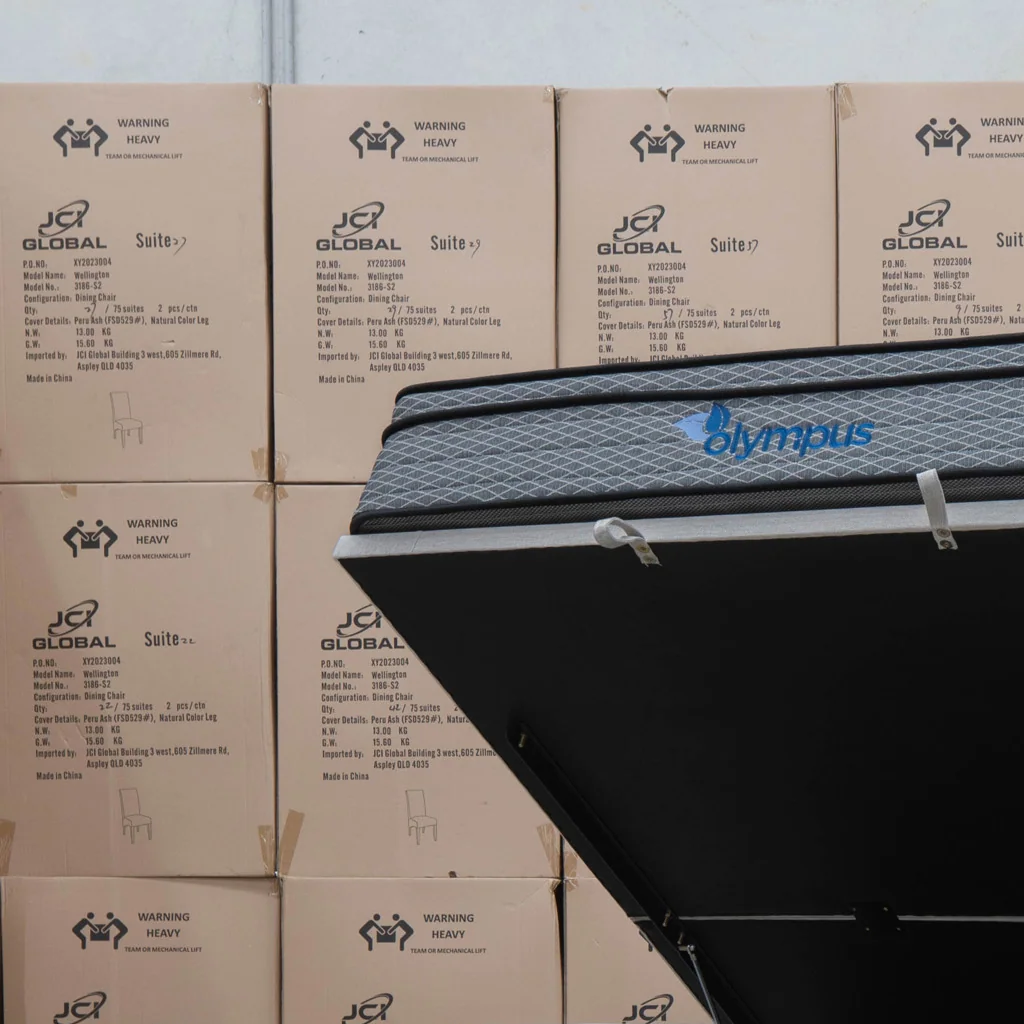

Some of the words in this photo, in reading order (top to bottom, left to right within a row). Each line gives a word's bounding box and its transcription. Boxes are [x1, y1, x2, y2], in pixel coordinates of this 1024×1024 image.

[118, 118, 170, 127] WARNING
[414, 122, 466, 131] WARNING
[694, 124, 746, 133] WARNING
[127, 135, 161, 144] HEAVY
[423, 138, 457, 147] HEAVY
[989, 134, 1023, 143] HEAVY
[703, 140, 737, 149] HEAVY
[37, 207, 87, 233] JCI
[332, 208, 382, 234] JCI
[613, 211, 662, 238] JCI
[898, 206, 948, 233] JCI
[22, 236, 107, 250] GLOBAL
[316, 237, 402, 251] GLOBAL
[597, 241, 682, 255] GLOBAL
[882, 236, 968, 250] GLOBAL
[74, 258, 112, 267] XY2023004
[648, 262, 687, 271] XY2023004
[367, 272, 403, 281] Wellington
[649, 275, 684, 285] Wellington
[933, 271, 969, 280] Wellington
[75, 281, 103, 290] 3186-S2
[934, 281, 962, 290] 3186-S2
[368, 294, 390, 303] Dining
[391, 294, 409, 303] Chair
[649, 297, 671, 307] Dining
[672, 297, 690, 306] Chair
[151, 316, 177, 325] Natural
[178, 316, 196, 324] Color
[197, 316, 209, 326] Leg
[369, 363, 392, 373] Aspley
[393, 363, 406, 372] QLD
[407, 362, 425, 371] 4035
[27, 374, 44, 383] Made
[45, 374, 52, 383] in
[54, 373, 72, 383] China
[127, 519, 178, 528] WARNING
[136, 535, 170, 544] HEAVY
[47, 606, 96, 633] JCI
[336, 608, 385, 634] JCI
[32, 636, 116, 650] GLOBAL
[320, 636, 404, 650] GLOBAL
[83, 656, 121, 665] XY2023004
[372, 671, 407, 680] Wellington
[372, 692, 394, 702] Dining
[395, 692, 413, 701] Chair
[87, 759, 109, 769] Aspley
[110, 759, 123, 768] QLD
[124, 759, 142, 768] 4035
[323, 772, 341, 781] Made
[342, 772, 348, 780] in
[350, 770, 368, 780] China
[138, 913, 190, 922] WARNING
[423, 914, 474, 924] WARNING
[146, 929, 181, 938] HEAVY
[432, 930, 466, 939] HEAVY
[53, 997, 104, 1023] JCI
[341, 999, 391, 1024] JCI
[622, 1000, 671, 1023] JCI
